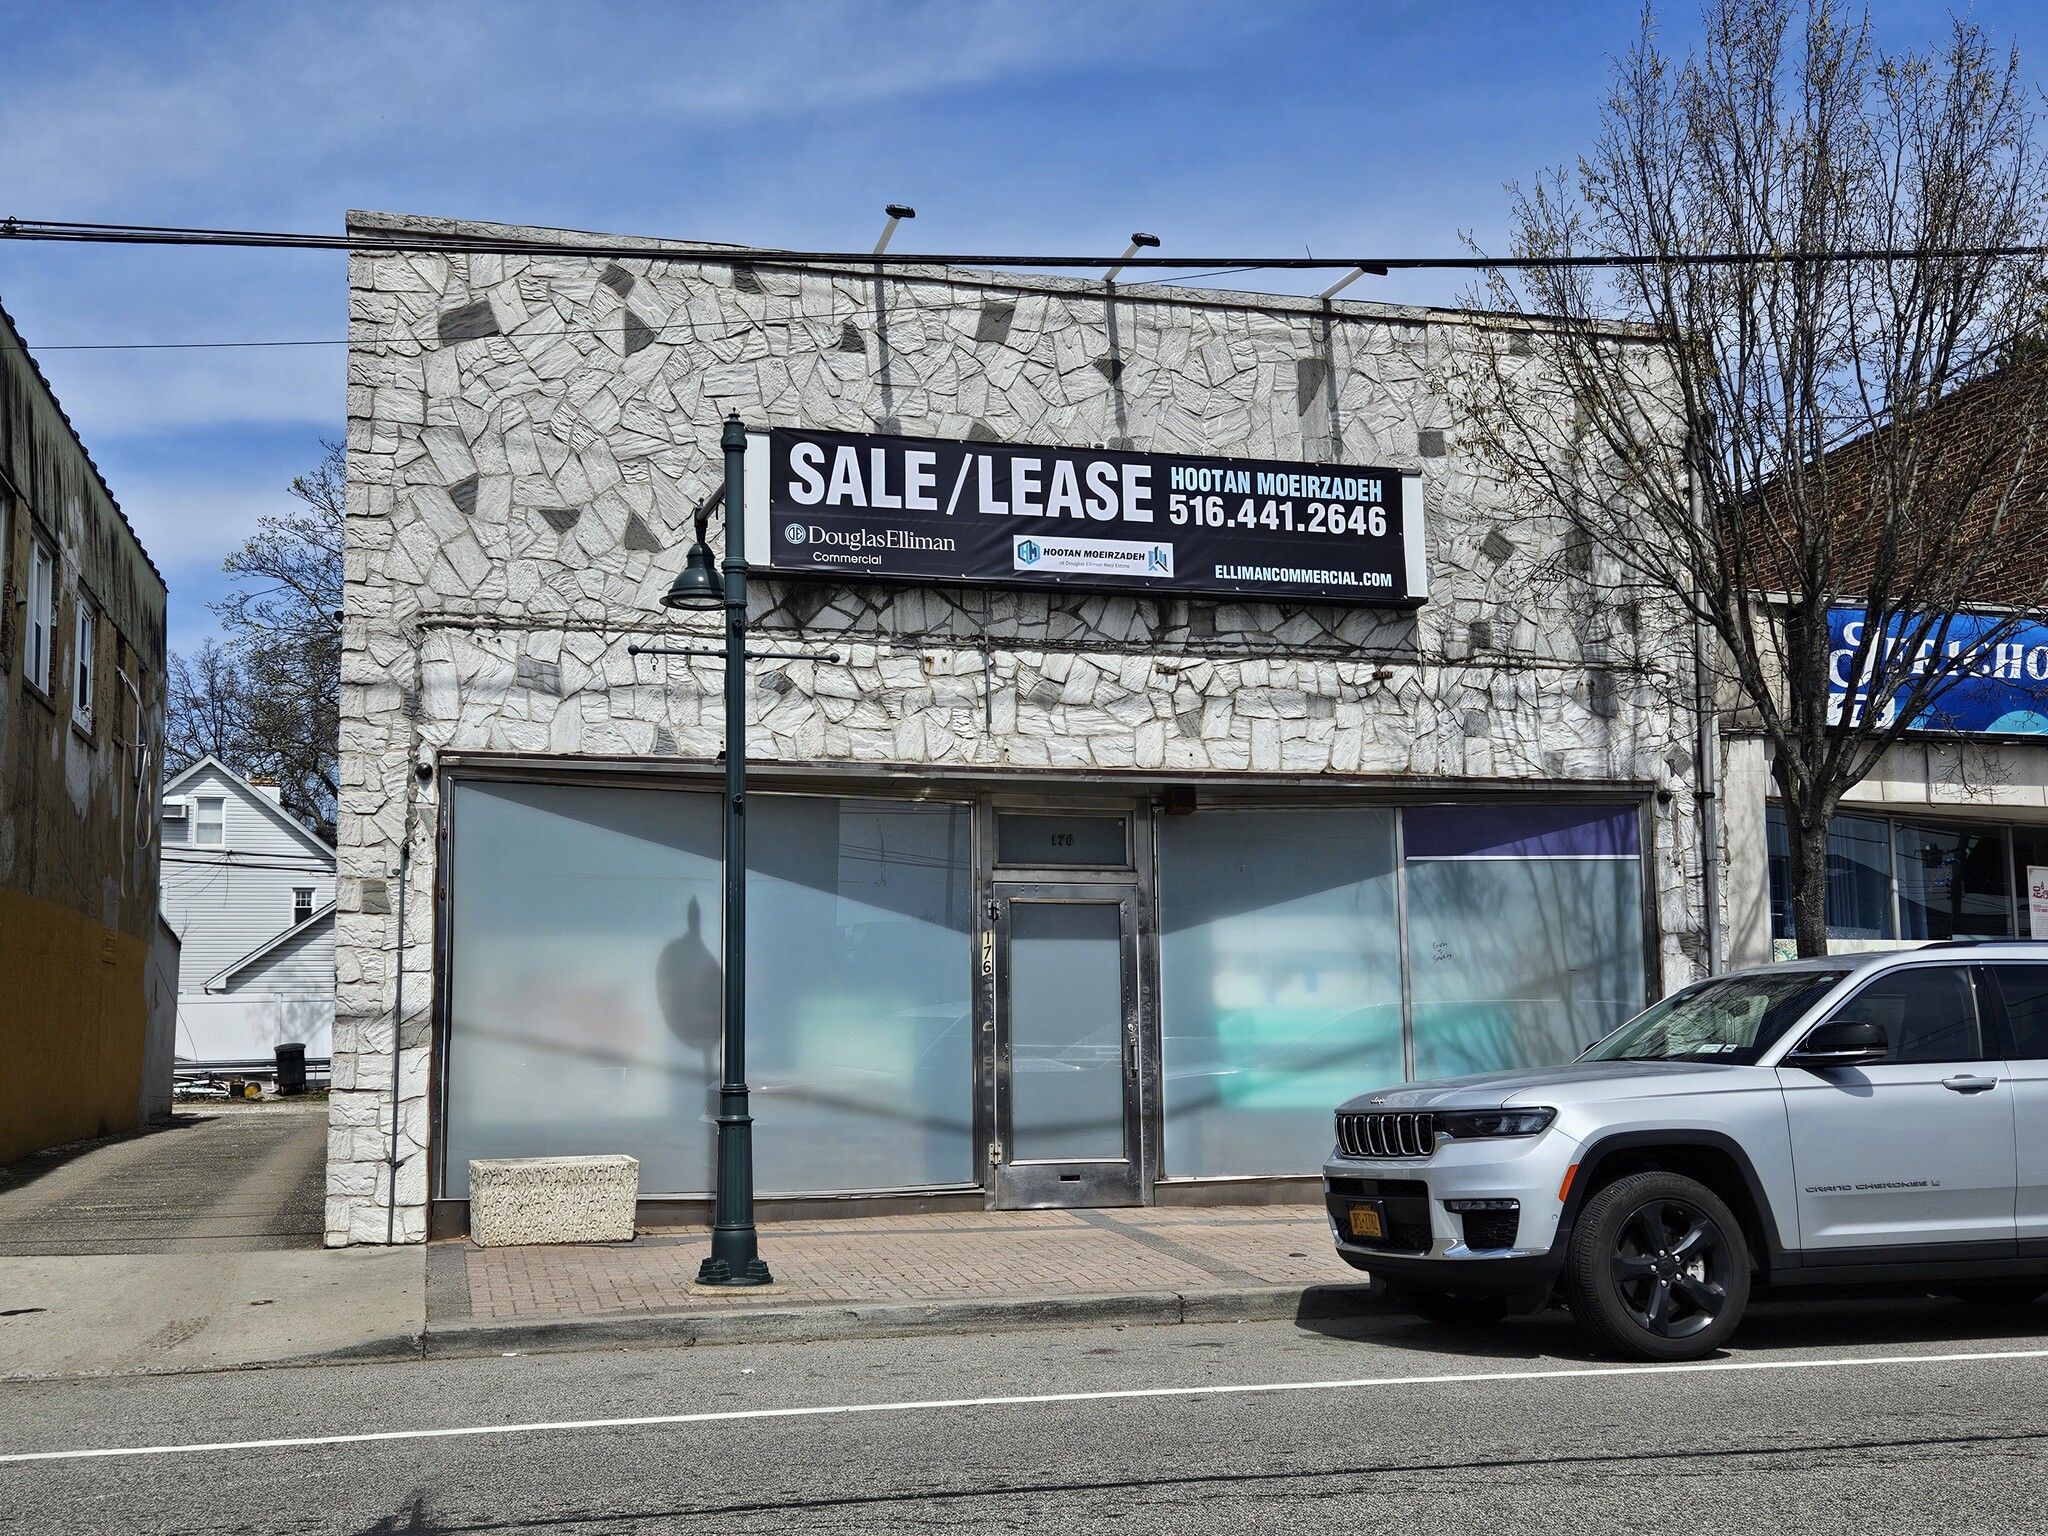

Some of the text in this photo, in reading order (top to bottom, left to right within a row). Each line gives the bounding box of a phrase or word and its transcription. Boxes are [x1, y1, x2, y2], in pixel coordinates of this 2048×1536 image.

[1170, 466, 1383, 503] HOOTAN MOEIRZADEH
[1168, 494, 1388, 537] 516.441.2646
[812, 551, 882, 565] Commercial
[1043, 547, 1081, 558] HOOTAN
[1083, 550, 1146, 561] MOEIRZADEH
[1215, 564, 1393, 588] ELLIMANCOMMERCIAL.COM
[1051, 833, 1074, 847] 176
[982, 931, 992, 974] 176
[1805, 1184, 1852, 1193] GRAND
[1855, 1180, 1928, 1190] CHEROKEE
